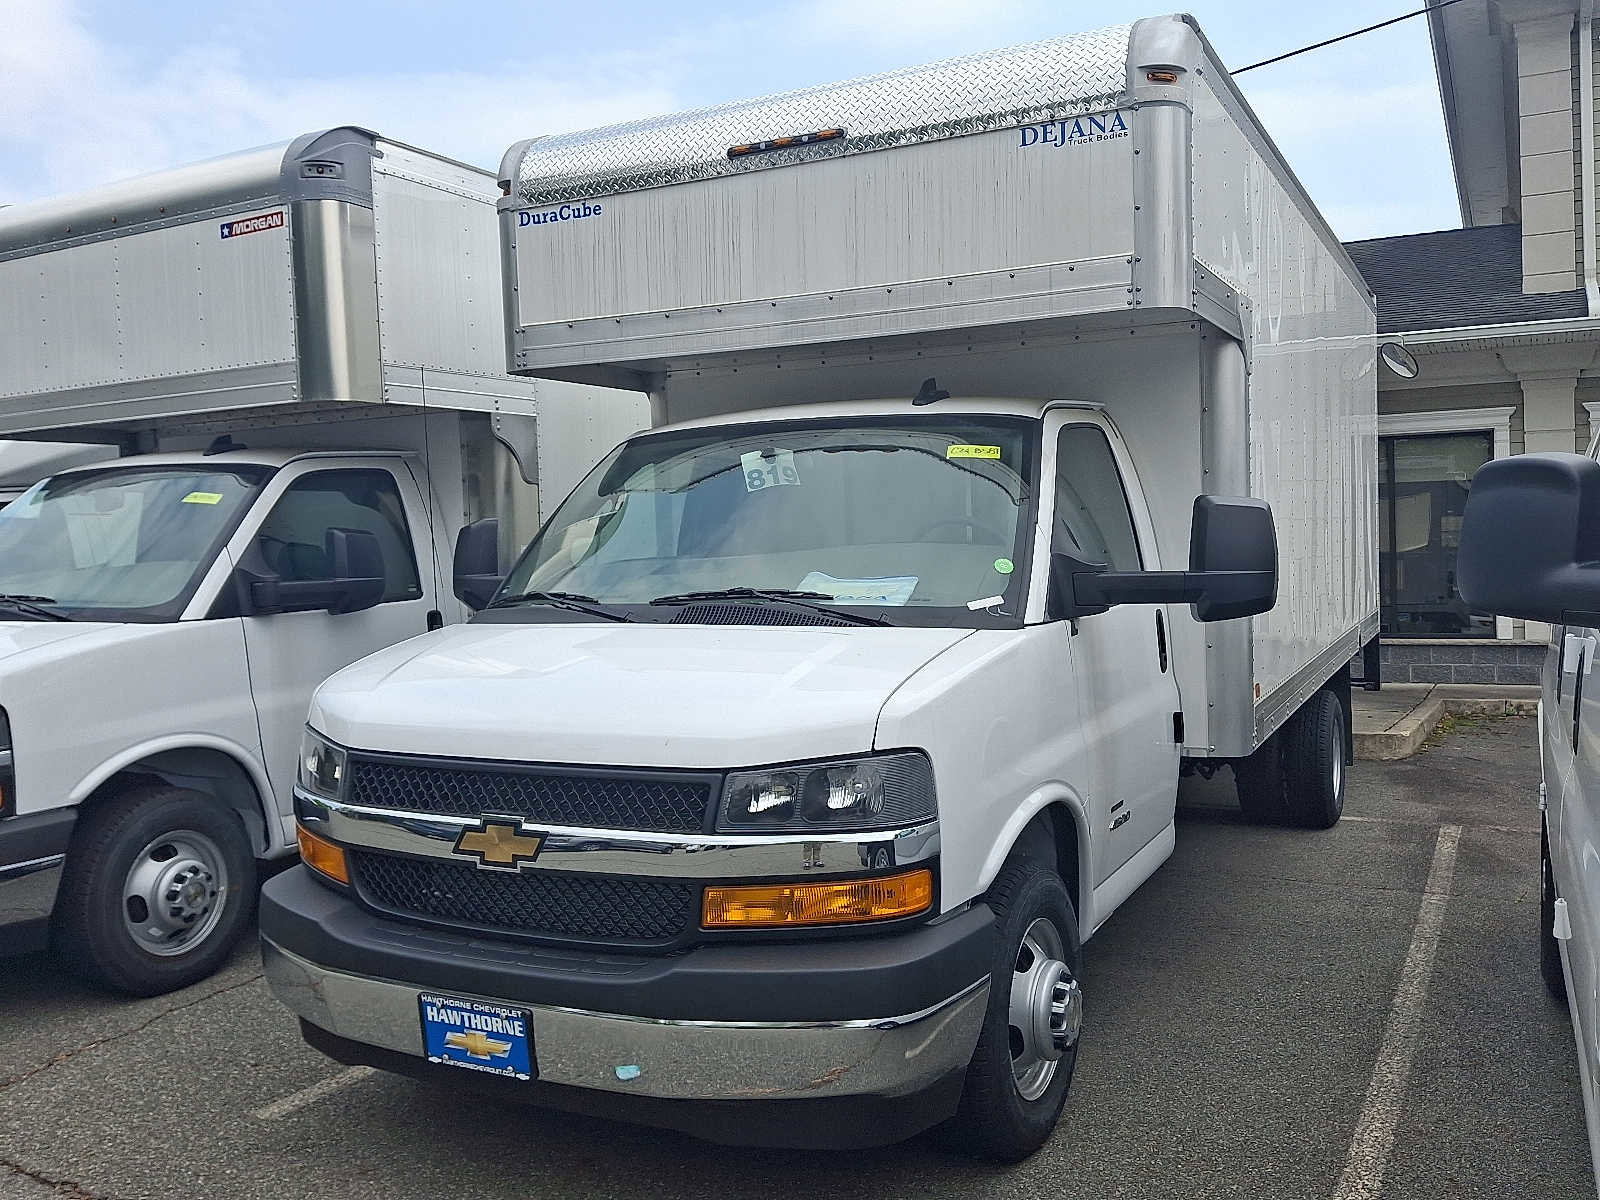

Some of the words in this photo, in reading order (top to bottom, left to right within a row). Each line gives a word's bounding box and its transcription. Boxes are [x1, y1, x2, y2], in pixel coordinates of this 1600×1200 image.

[1018, 110, 1128, 148] DEJANA
[1068, 136, 1094, 146] Truck
[1096, 131, 1128, 142] Bodies
[231, 213, 282, 235] MORGAN
[518, 202, 602, 227] DuraCube
[746, 466, 799, 489] 819
[421, 994, 472, 1010] HAWTHORNE
[472, 1003, 522, 1018] CHEVROLET
[426, 1005, 525, 1037] HAWTHORNE
